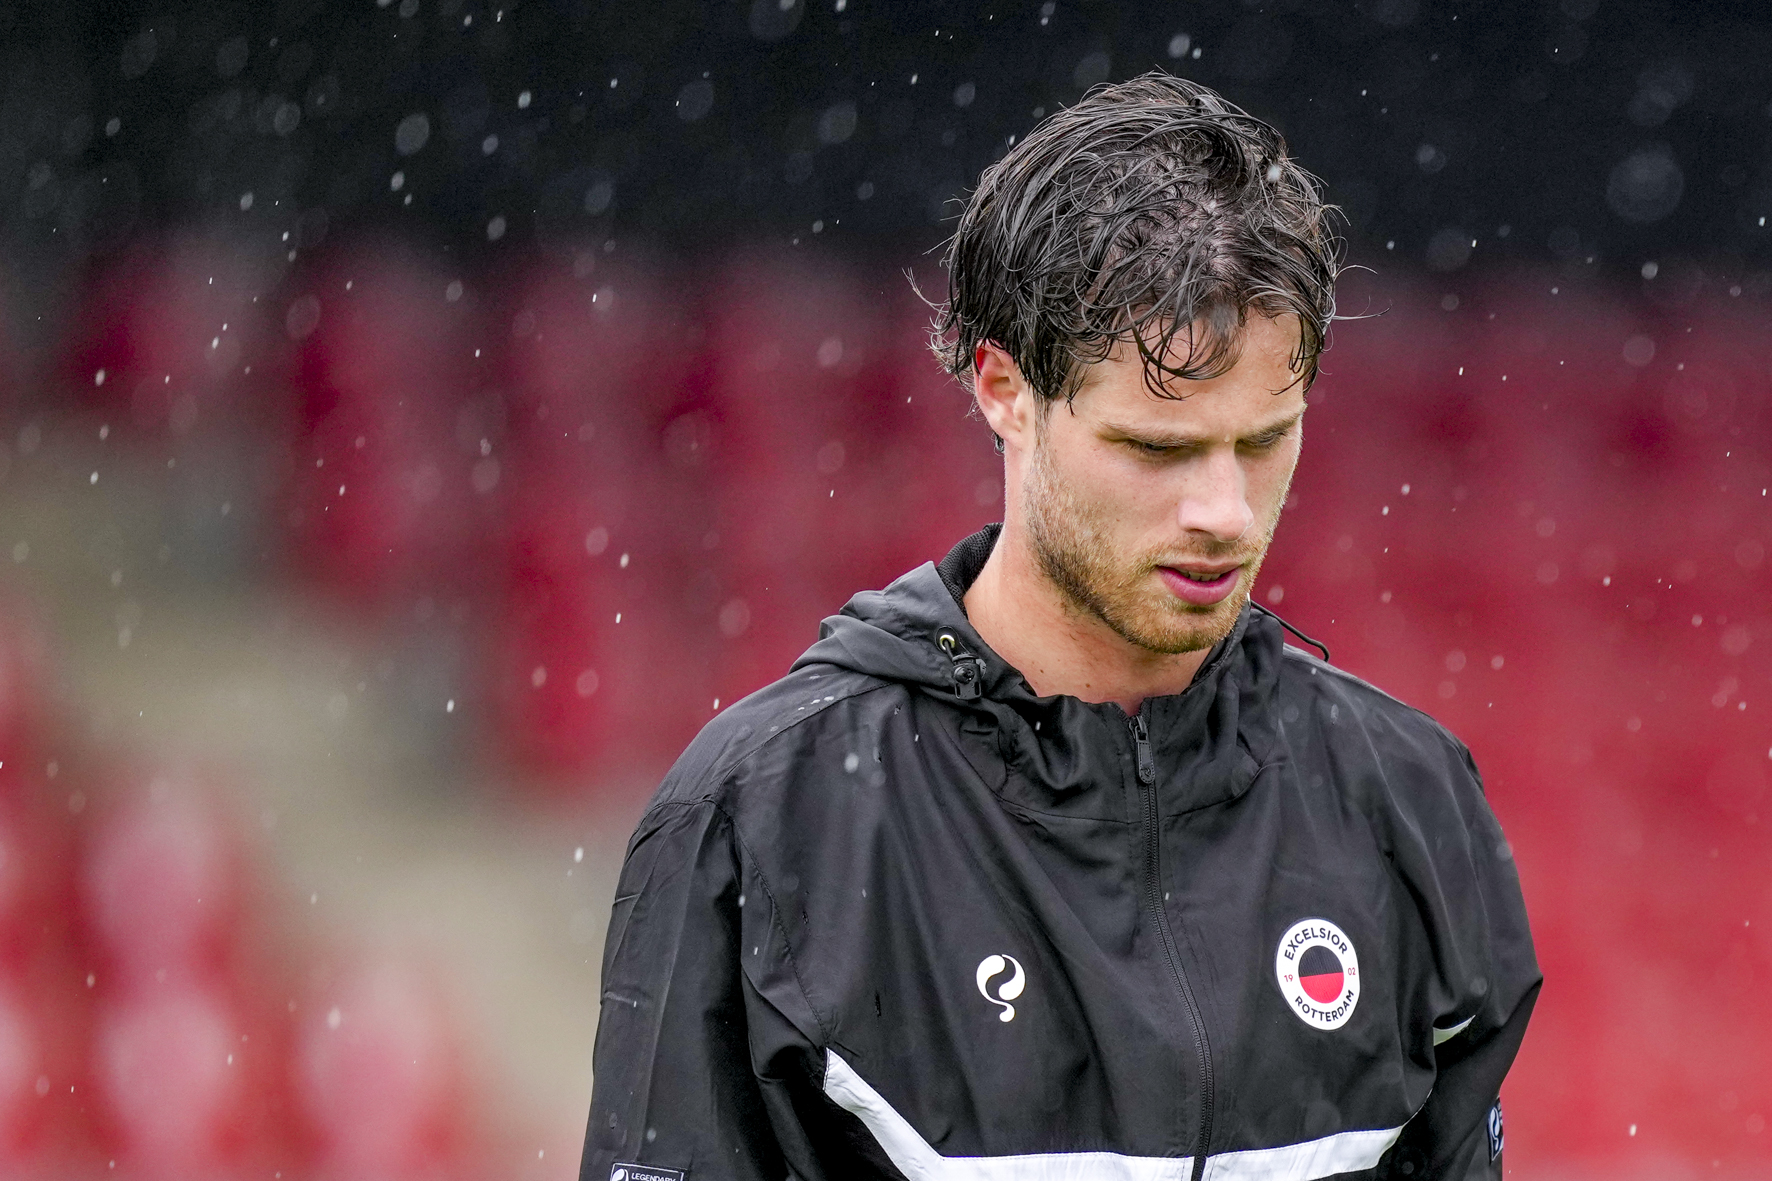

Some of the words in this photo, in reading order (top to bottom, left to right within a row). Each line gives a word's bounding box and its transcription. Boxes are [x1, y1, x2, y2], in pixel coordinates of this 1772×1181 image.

[1284, 927, 1348, 961] EXCELSIOR
[1284, 974, 1294, 982] 19
[1347, 967, 1356, 976] 02
[1294, 989, 1354, 1022] ROTTERDAM
